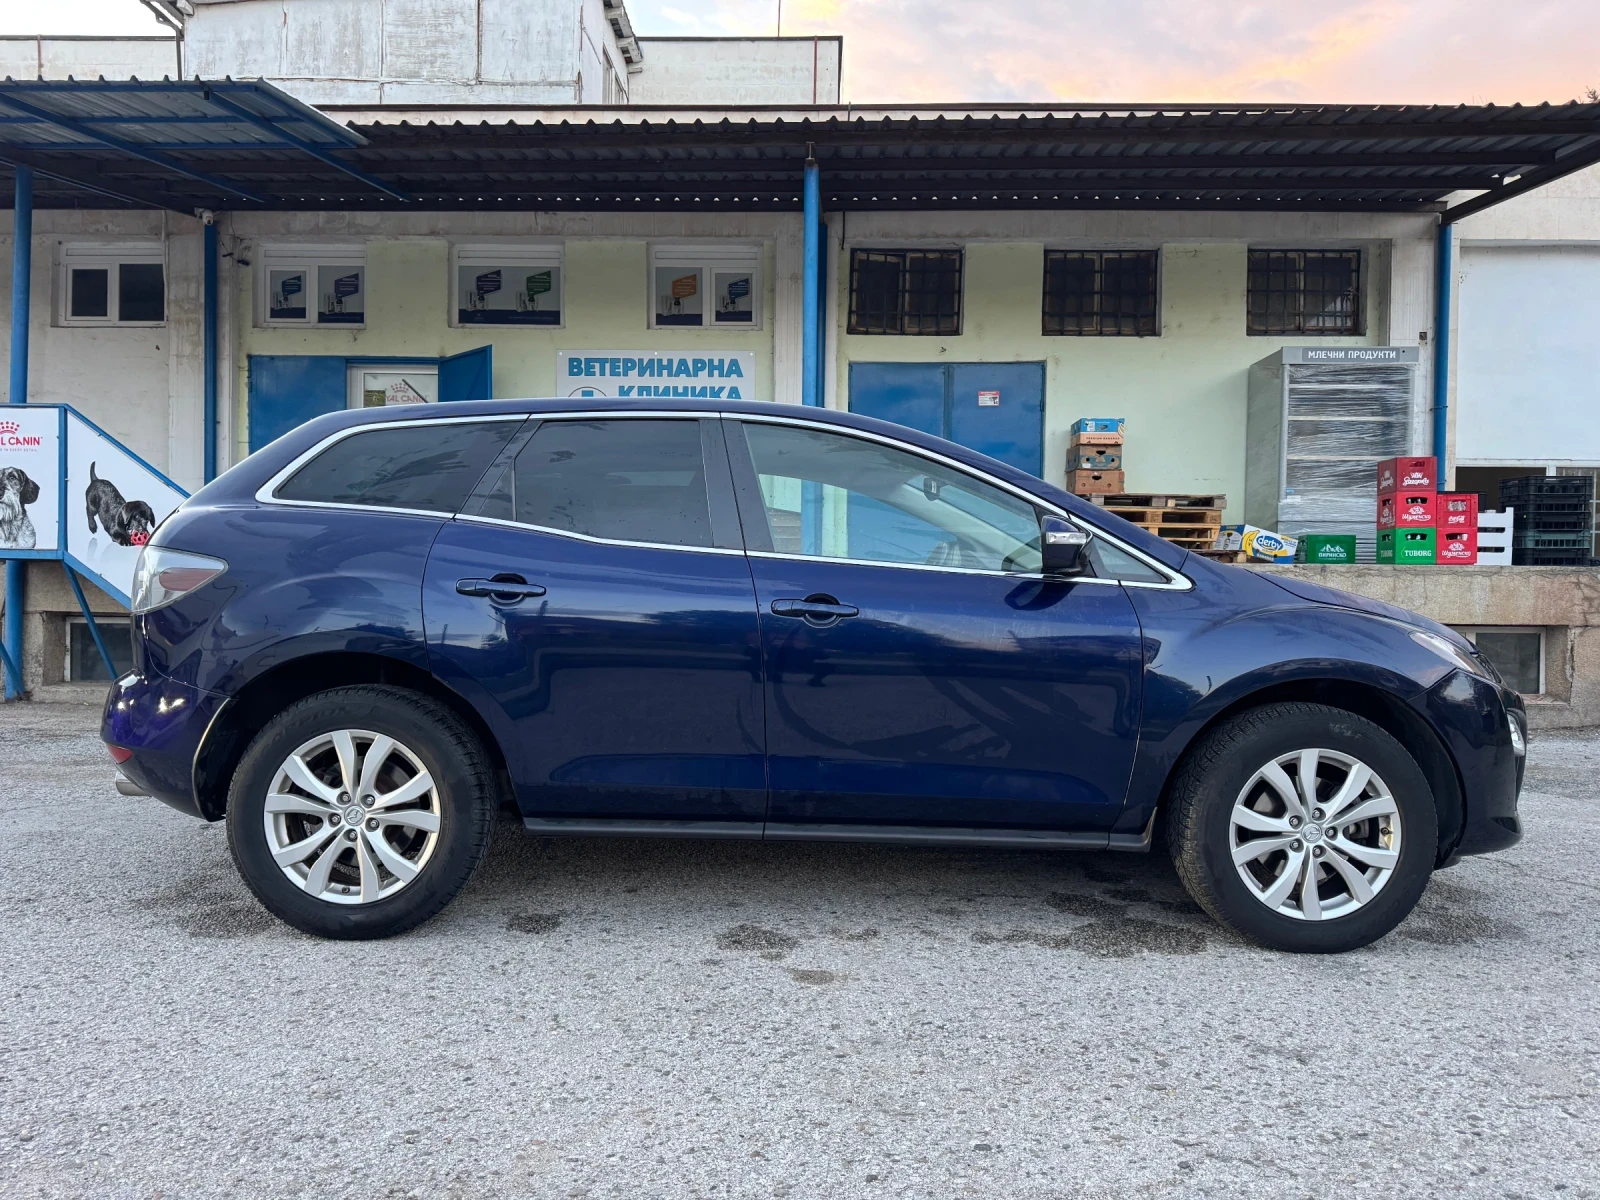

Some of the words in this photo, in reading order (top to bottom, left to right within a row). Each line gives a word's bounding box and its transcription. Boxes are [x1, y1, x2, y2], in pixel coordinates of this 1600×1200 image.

[1308, 350, 1345, 359] МЛЕЧНИ
[1348, 350, 1396, 360] ПРОДУКТИ
[568, 357, 744, 378] ВЕТЕРИНАРНА
[8, 436, 40, 446] CANIN
[1257, 535, 1282, 551] derby
[1404, 549, 1432, 557] TUBORG
